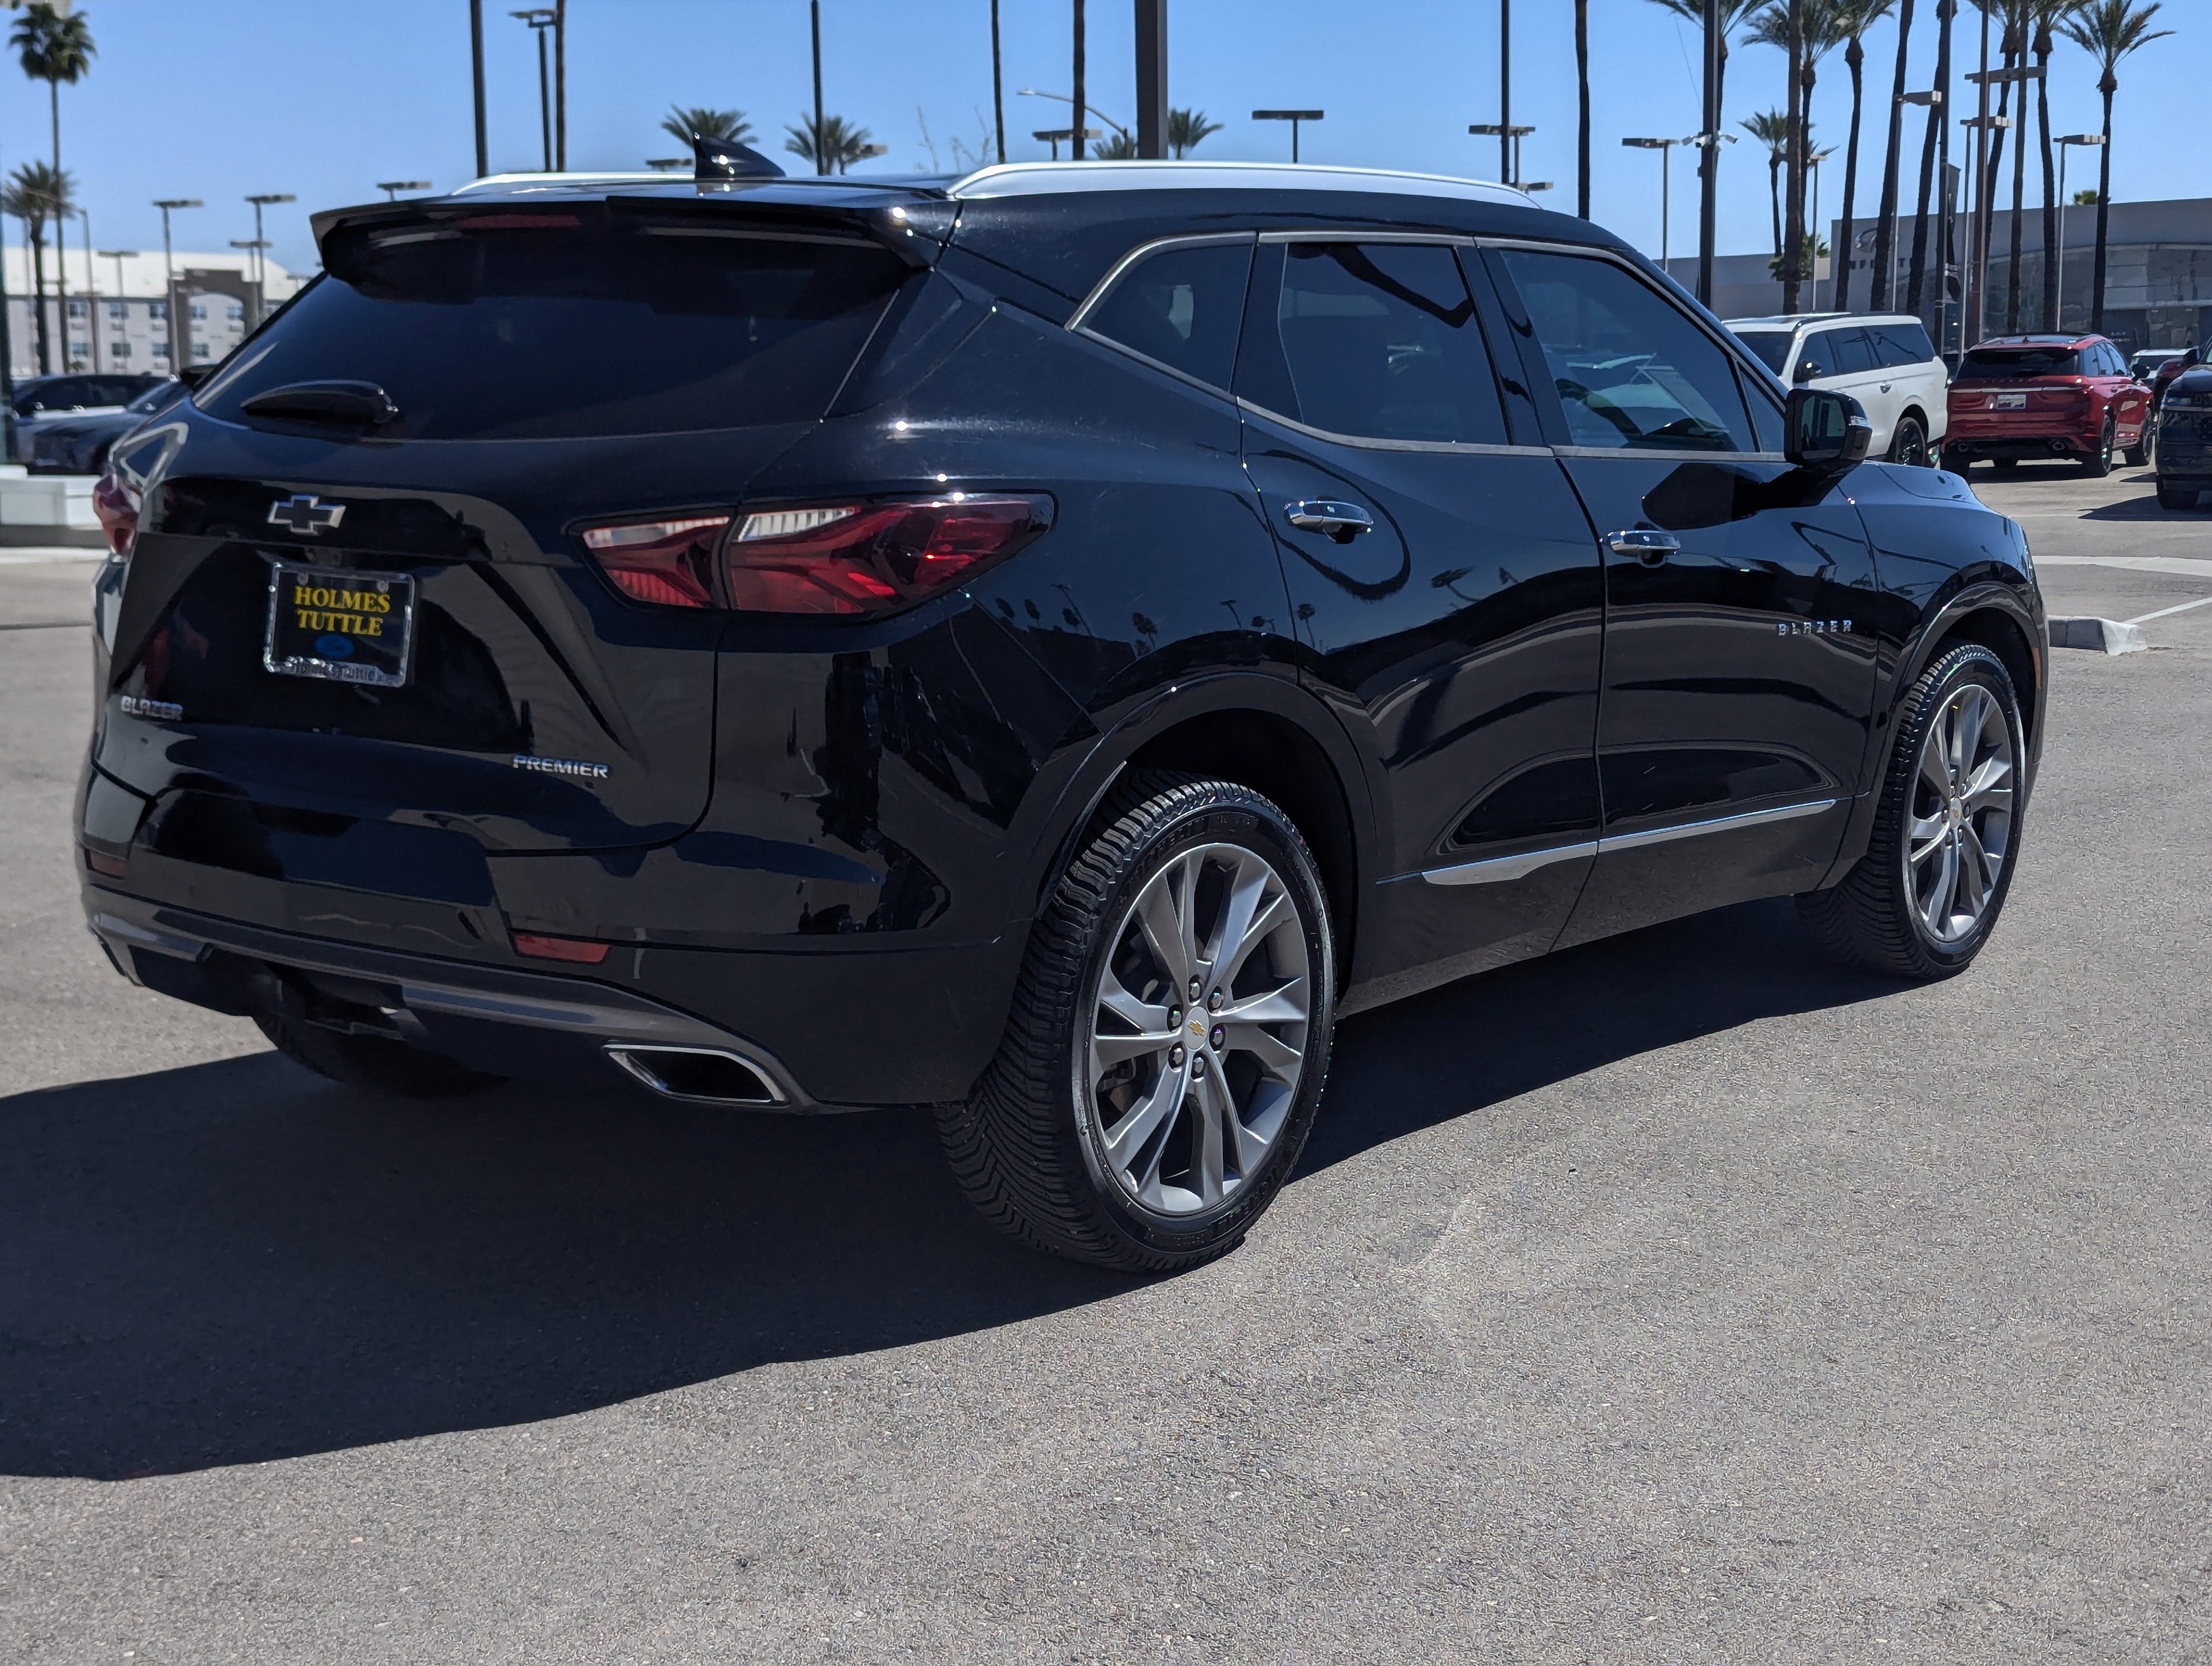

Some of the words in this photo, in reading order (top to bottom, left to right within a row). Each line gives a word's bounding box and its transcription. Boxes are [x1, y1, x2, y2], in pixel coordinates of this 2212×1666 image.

[293, 586, 391, 613] HOLMES
[296, 609, 384, 637] TUTTLE
[1778, 619, 1852, 637] BLAZER
[513, 754, 608, 778] PREMIER
